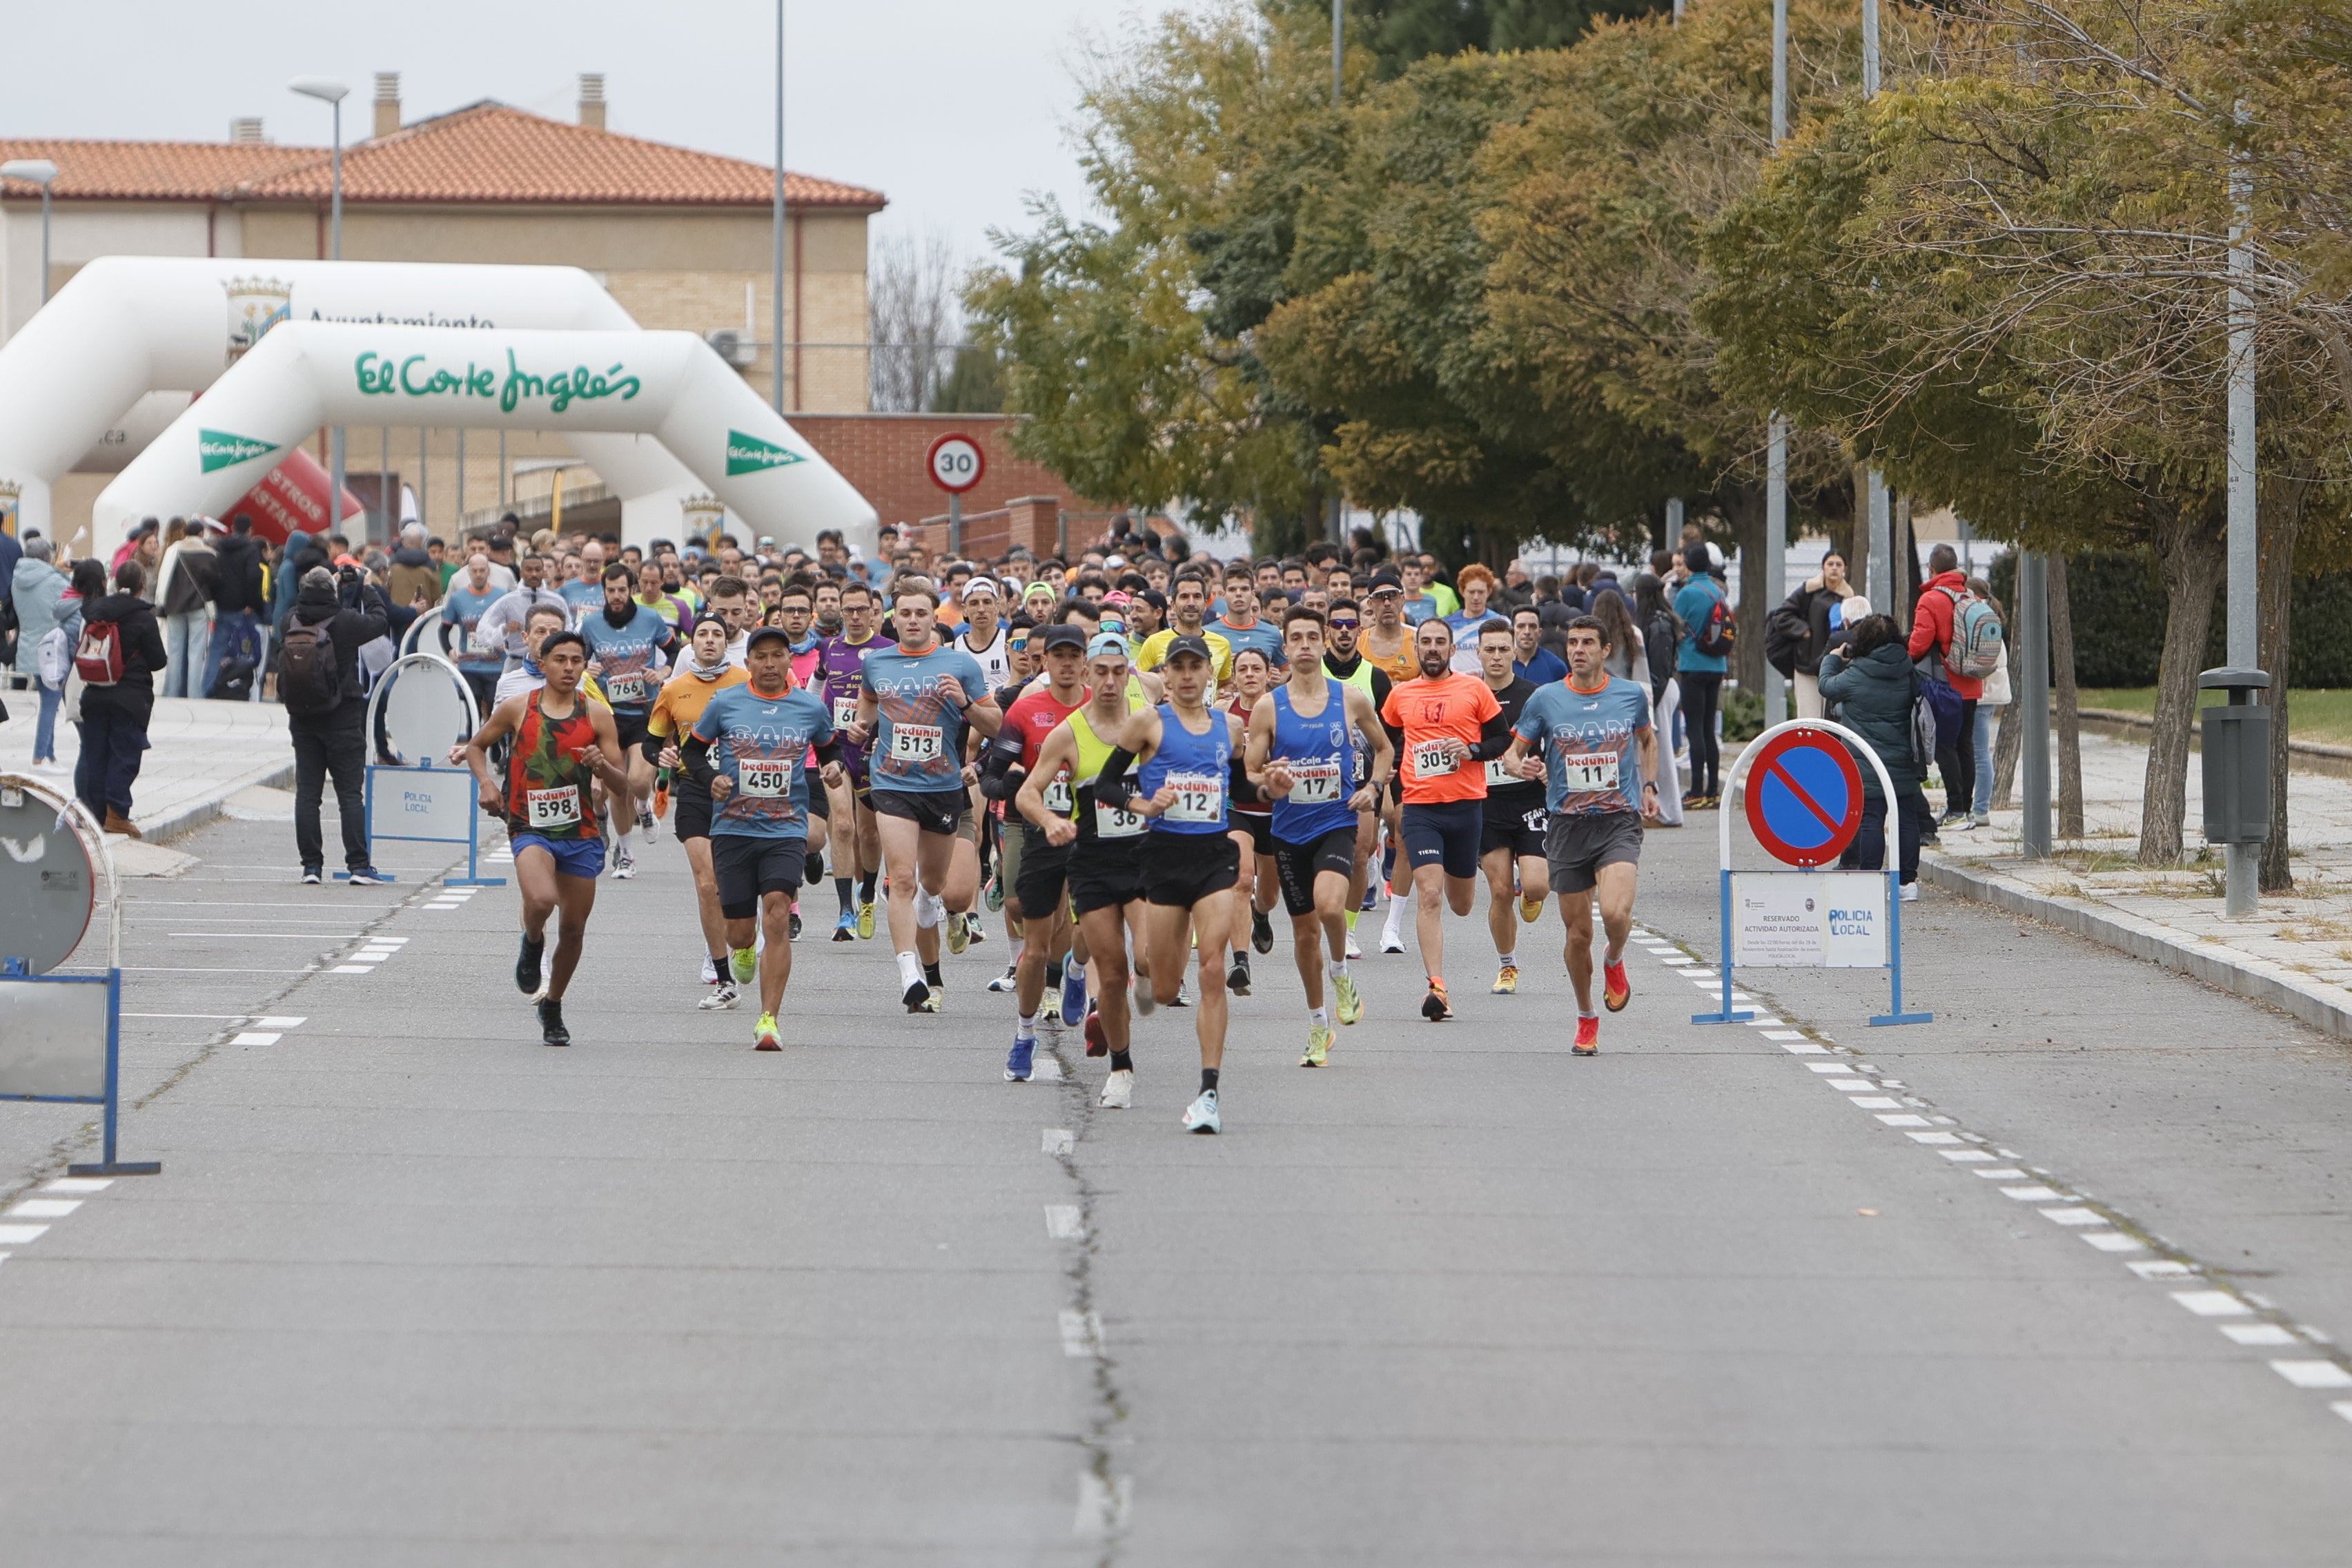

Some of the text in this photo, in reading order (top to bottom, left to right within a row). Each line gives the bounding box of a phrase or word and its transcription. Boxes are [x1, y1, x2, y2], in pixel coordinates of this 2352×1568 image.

[354, 351, 396, 394] El
[398, 354, 495, 398] Corte
[941, 453, 971, 472] 30
[614, 682, 638, 696] 766
[729, 724, 808, 749] SAN
[894, 725, 941, 738] bedunia
[1553, 718, 1633, 745] SAN
[900, 736, 934, 754] 513
[741, 762, 791, 772] bedunia
[1421, 751, 1451, 770] 305
[1567, 756, 1617, 766] bedunia
[747, 772, 783, 788] 450
[1581, 766, 1603, 783] 11
[529, 789, 578, 801] bedunia
[1303, 778, 1326, 795] 17
[404, 792, 431, 803] POLICIA
[1182, 792, 1207, 812] 12
[405, 803, 429, 814] LOCAL
[537, 798, 572, 818] 598
[1113, 810, 1138, 827] 36
[1829, 910, 1873, 921] POLICIA
[1832, 925, 1870, 935] LOCAL
